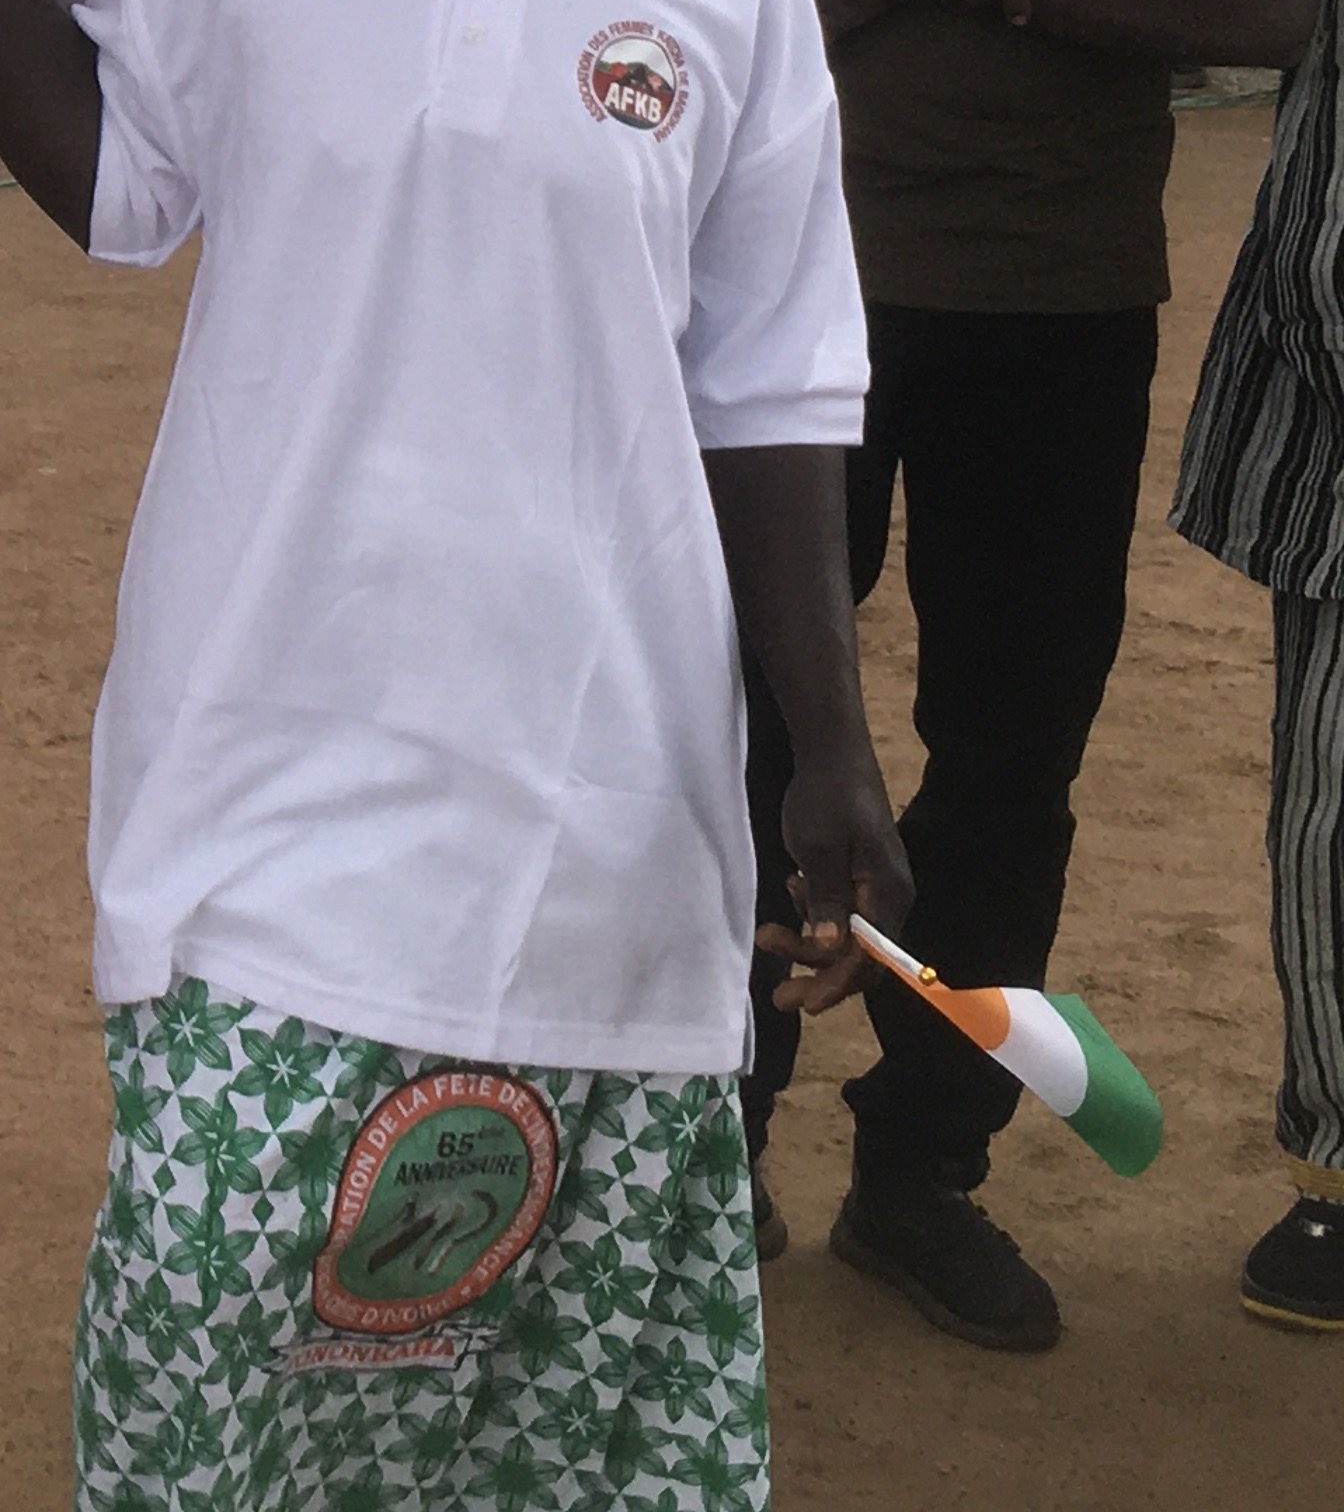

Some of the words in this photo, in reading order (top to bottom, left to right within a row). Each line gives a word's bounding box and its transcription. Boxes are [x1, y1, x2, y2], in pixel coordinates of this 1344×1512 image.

[603, 81, 663, 124] AFKB
[367, 1111, 399, 1152] DE
[395, 1085, 430, 1118] LA
[433, 1072, 495, 1101] FETE
[497, 1081, 531, 1114] DE
